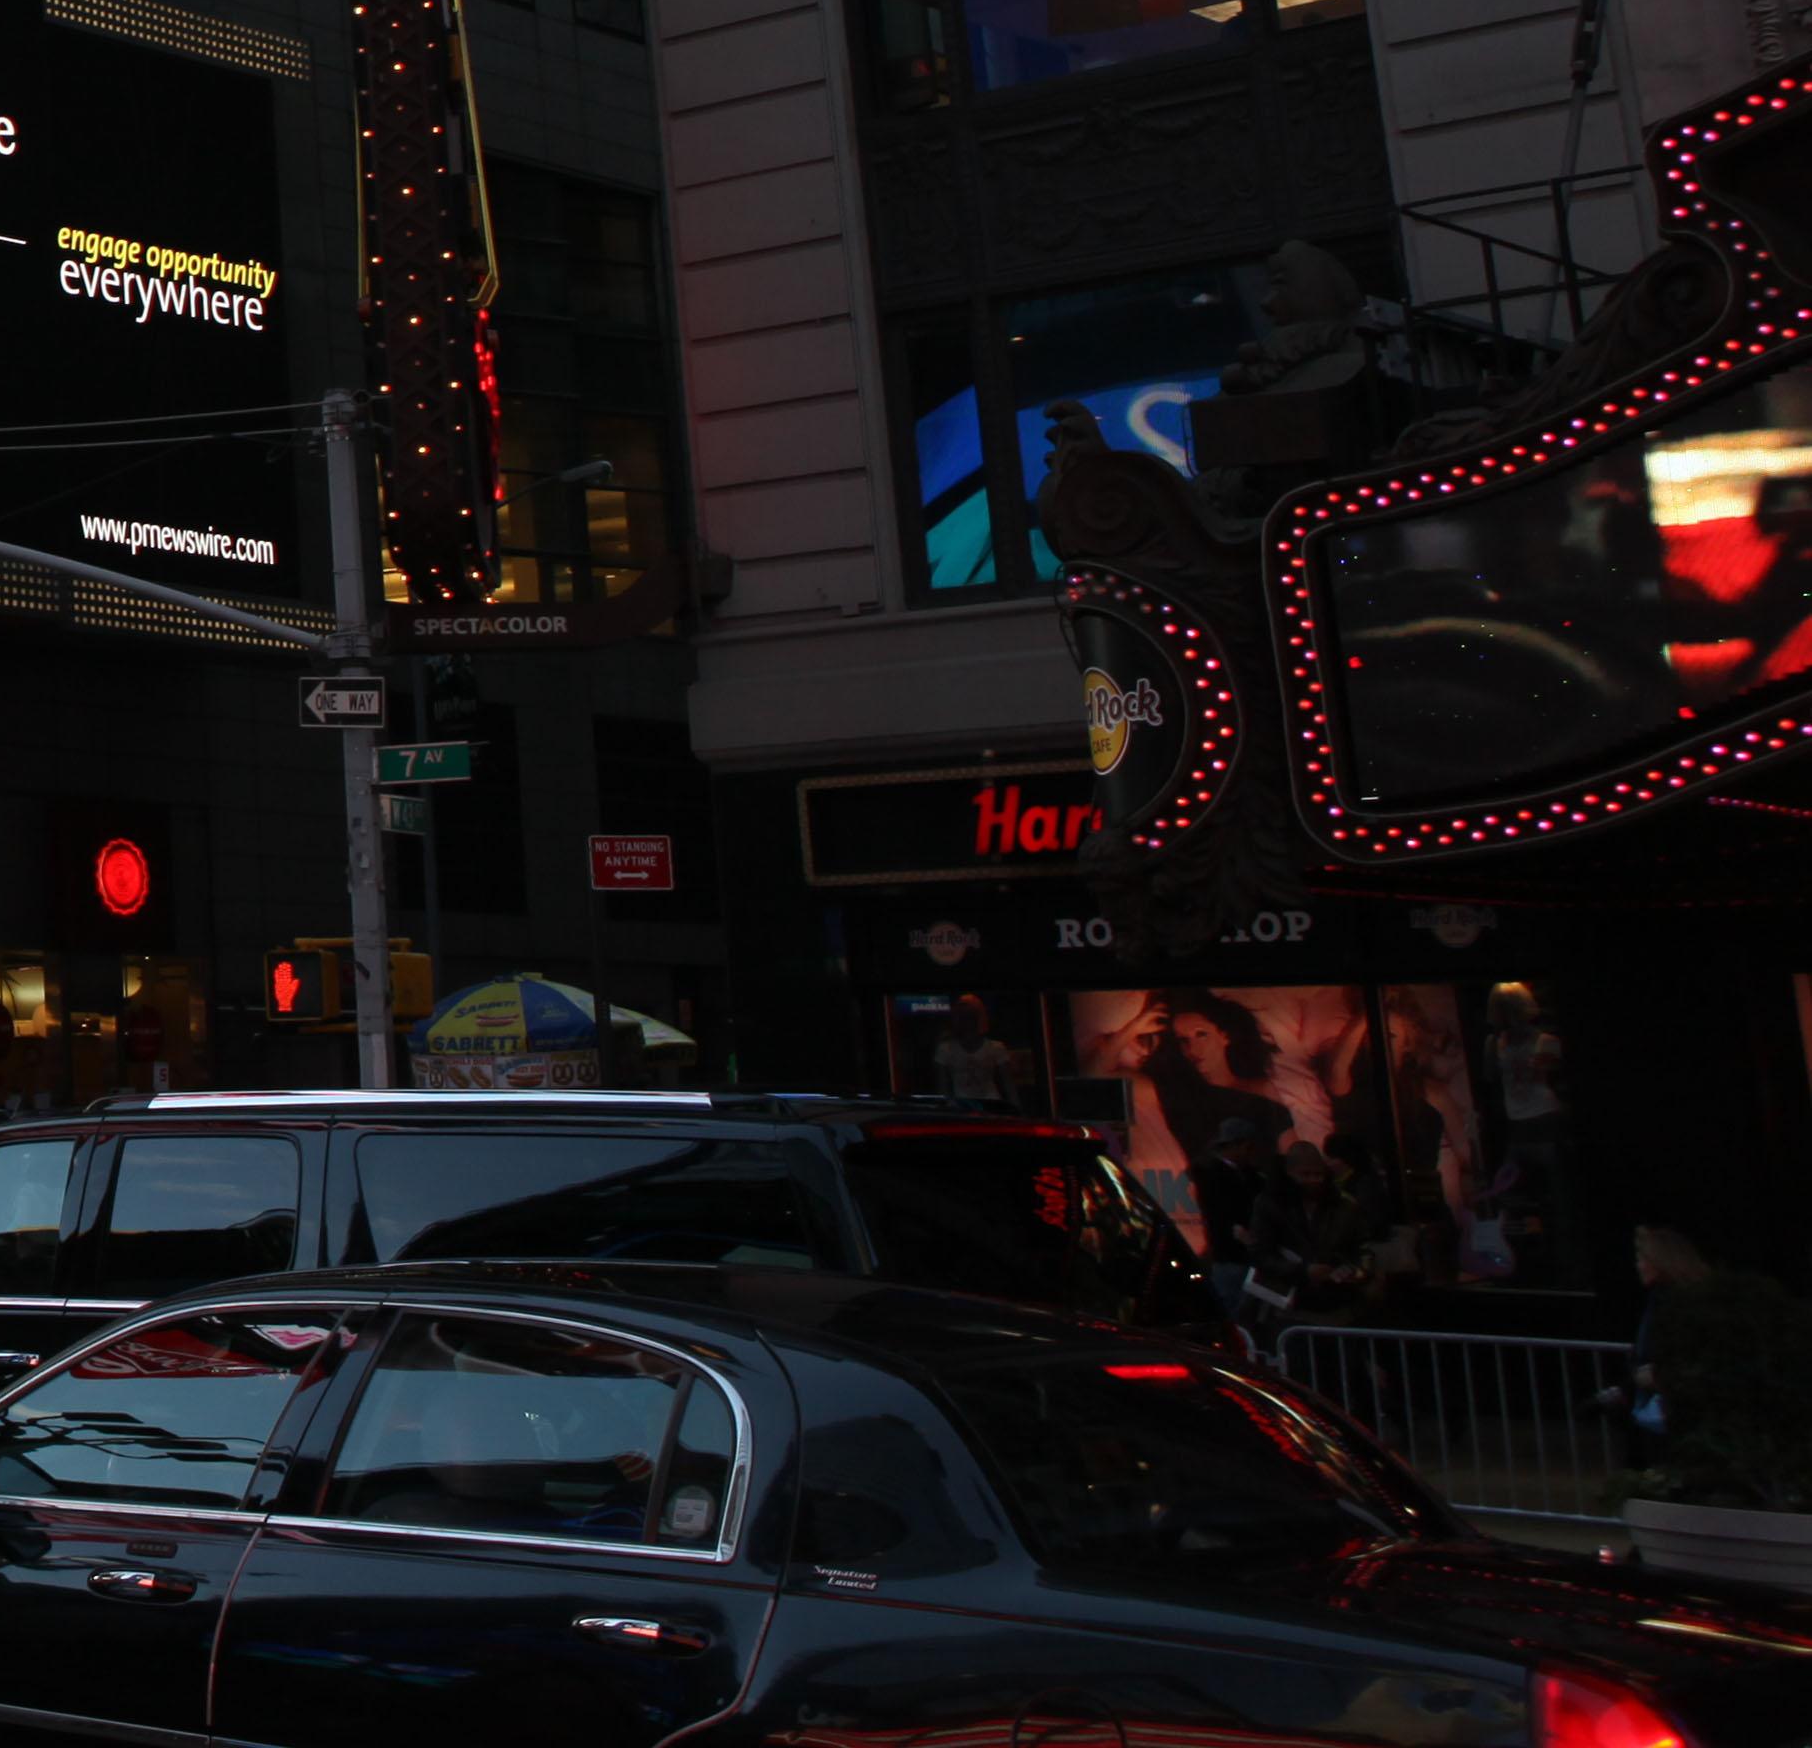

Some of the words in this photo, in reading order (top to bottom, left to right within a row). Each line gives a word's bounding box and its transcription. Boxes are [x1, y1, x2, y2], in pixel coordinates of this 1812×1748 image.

[56, 225, 140, 270] engage
[146, 242, 276, 297] opportunity
[59, 258, 264, 331] everywhere
[81, 513, 276, 565] www.prnewswire.com
[413, 615, 567, 636] SPECTACOLOR
[315, 693, 337, 711] ONE
[349, 694, 374, 711] WAY
[1095, 685, 1163, 732] Rock
[399, 751, 418, 778] 7
[424, 749, 446, 764] AV
[974, 783, 1104, 855] Har
[595, 842, 609, 852] NO
[614, 842, 664, 852] STANDING
[605, 856, 658, 866] ANYTIME
[1054, 918, 1112, 948] RO
[432, 1035, 521, 1052] SABRETT
